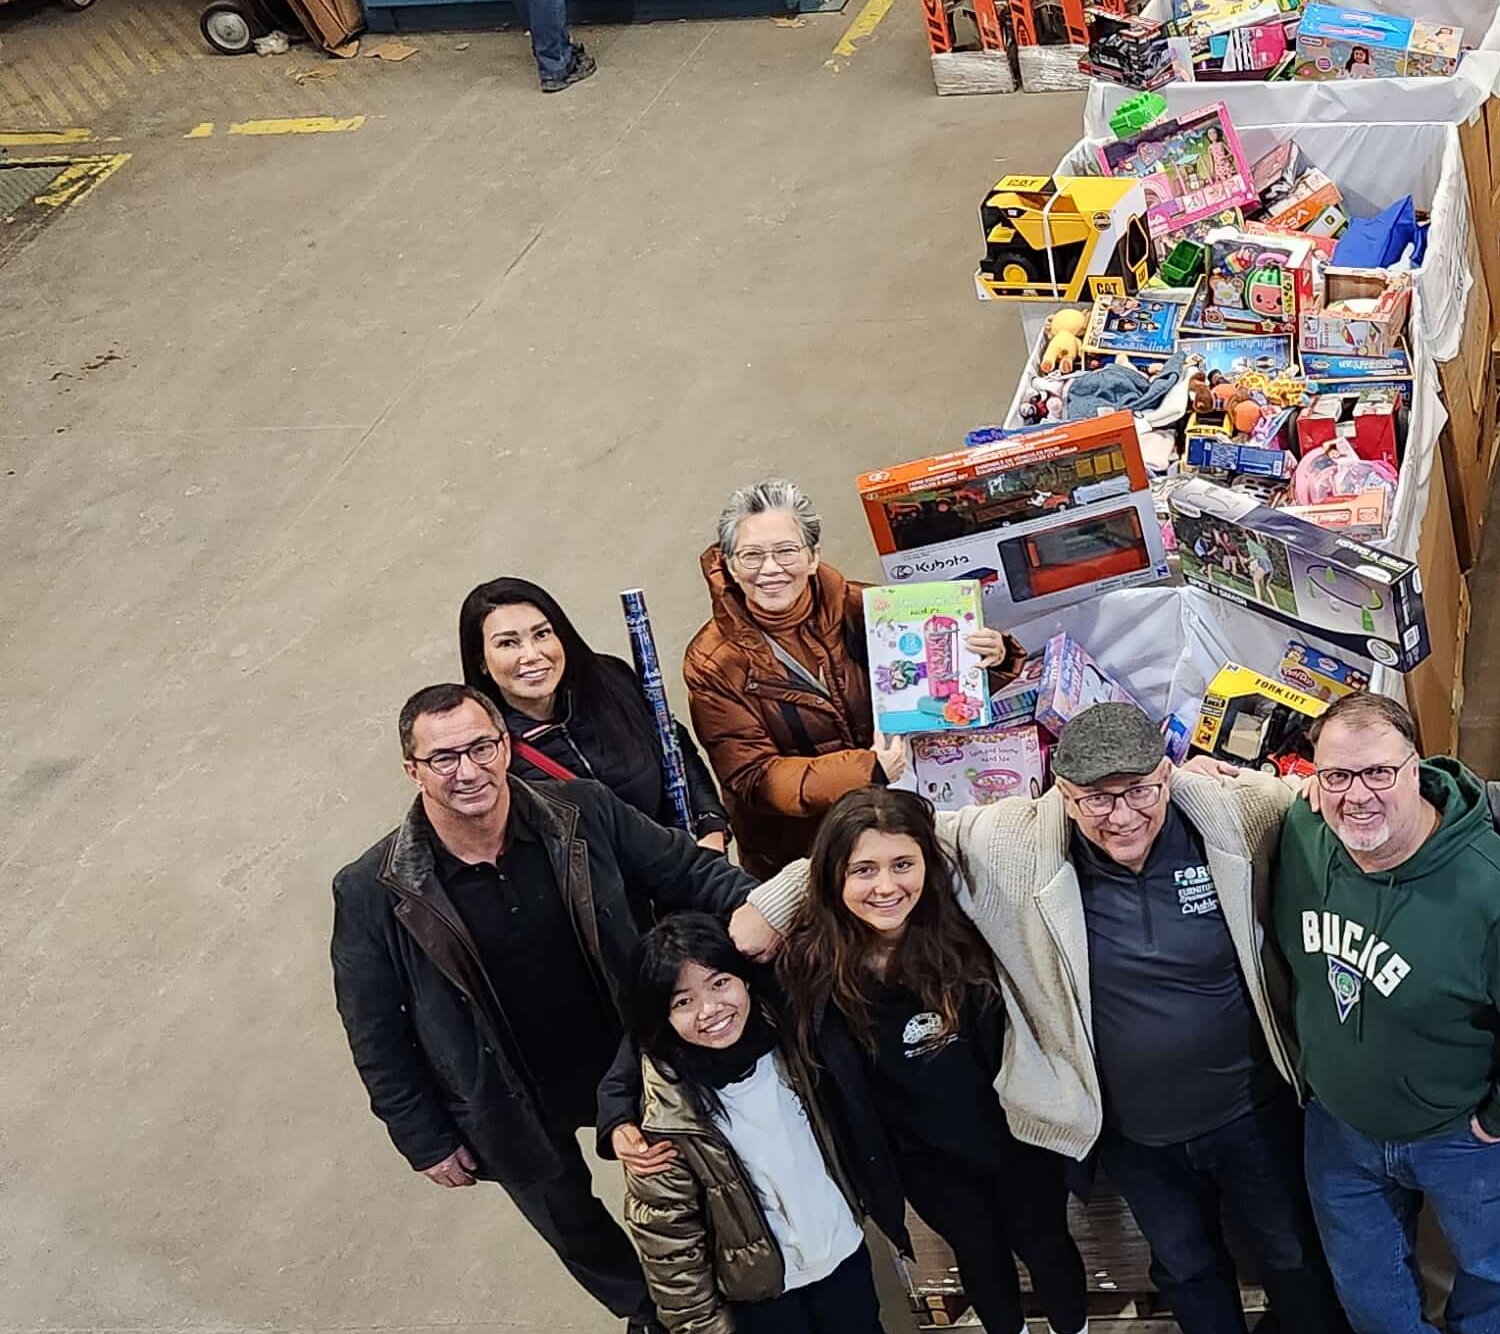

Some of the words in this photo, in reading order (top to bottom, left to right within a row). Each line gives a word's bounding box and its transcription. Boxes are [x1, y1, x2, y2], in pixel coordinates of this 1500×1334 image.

[1006, 178, 1037, 187] CAT
[1096, 281, 1118, 295] CAT
[915, 554, 969, 574] Kubota
[1254, 677, 1284, 696] FORK
[1284, 690, 1308, 706] LIFT
[1174, 864, 1212, 882] FOR
[1302, 910, 1412, 998] BUCKS
